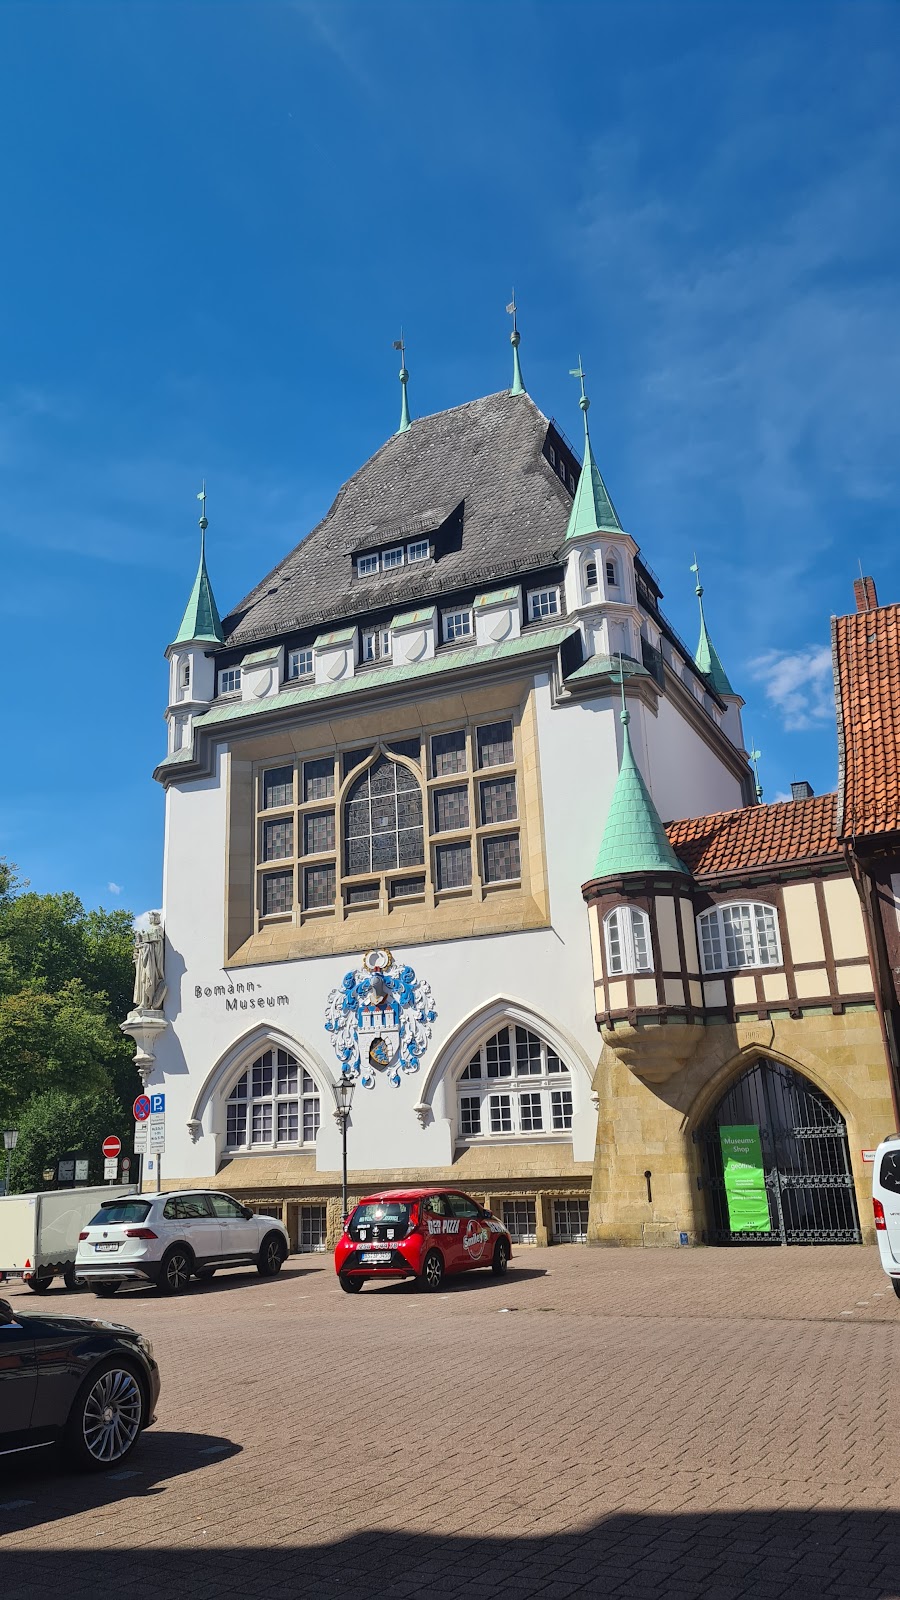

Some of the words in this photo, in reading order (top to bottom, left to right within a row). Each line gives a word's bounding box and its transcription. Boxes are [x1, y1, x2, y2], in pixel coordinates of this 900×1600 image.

[195, 982, 262, 998] Bomann-
[225, 995, 290, 1011] Museum
[153, 1096, 163, 1112] P
[733, 1145, 750, 1154] Shop
[442, 1219, 460, 1234] PIZZA
[463, 1228, 489, 1251] Smiley's
